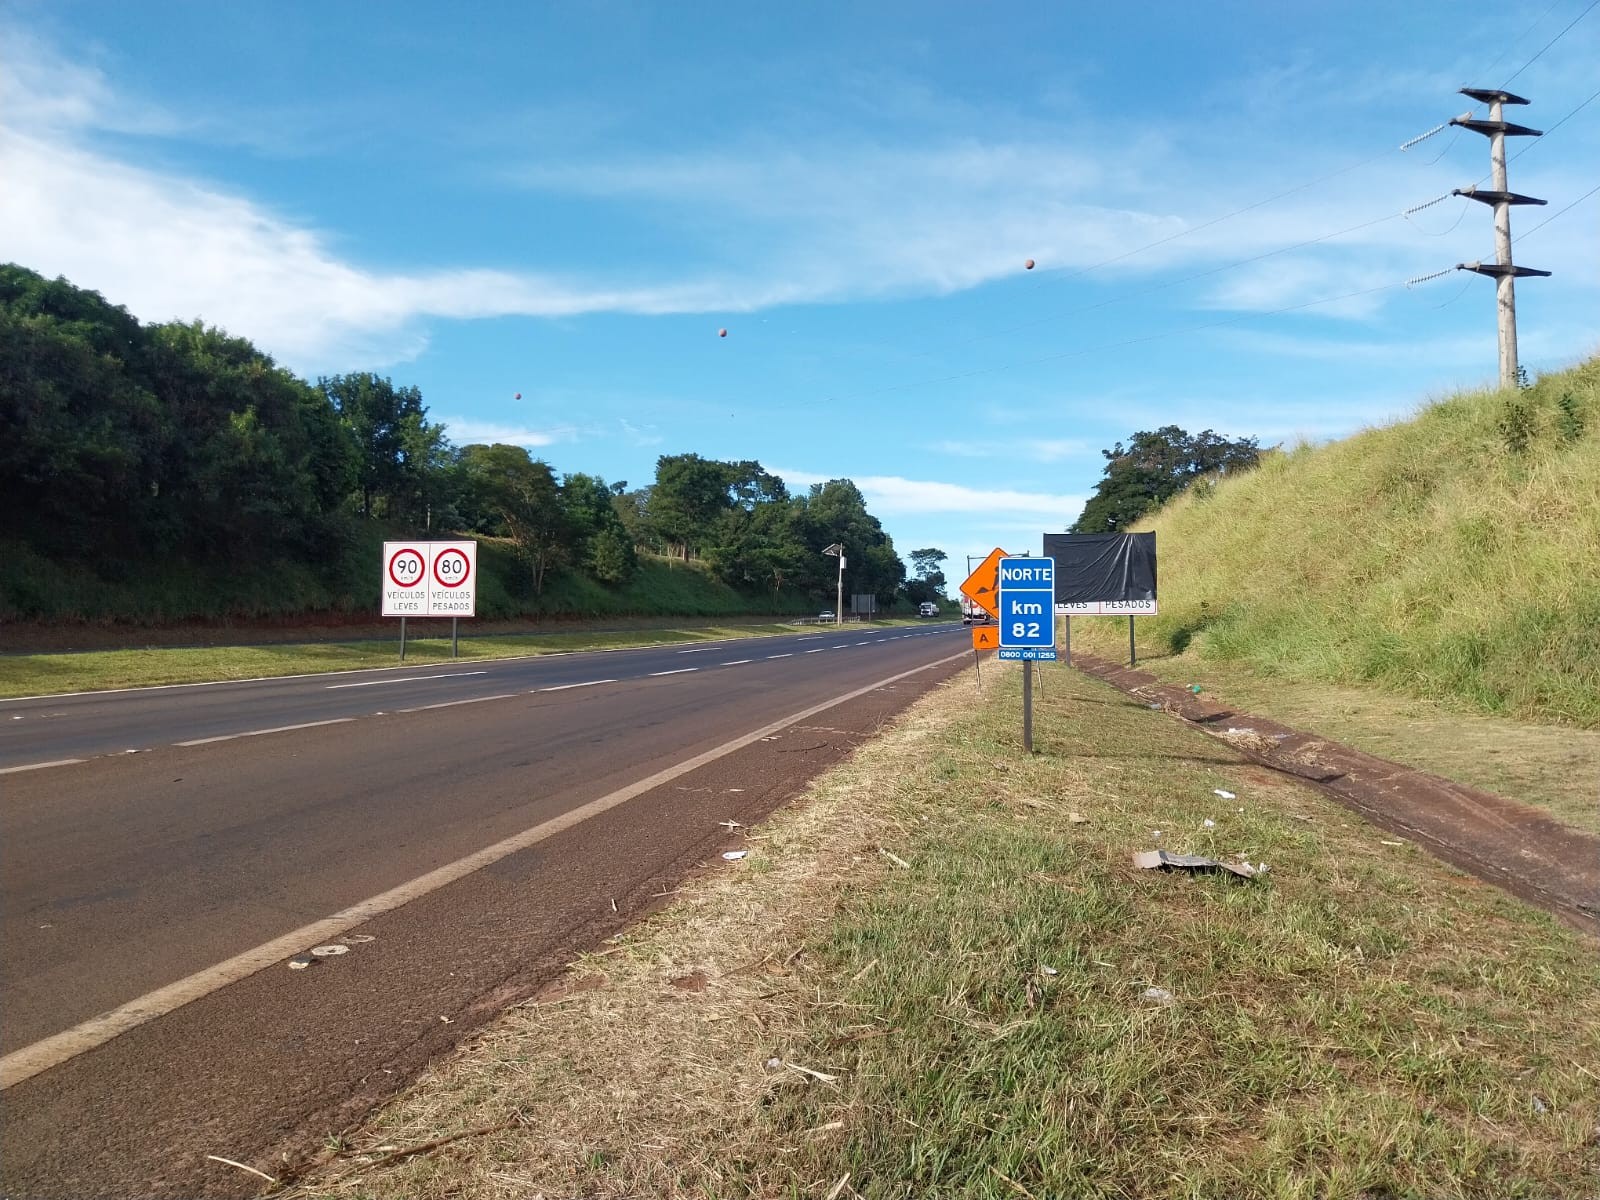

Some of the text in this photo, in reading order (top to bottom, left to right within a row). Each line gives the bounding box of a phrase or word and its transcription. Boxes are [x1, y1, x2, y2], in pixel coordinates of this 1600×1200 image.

[397, 560, 417, 574] 90
[442, 559, 462, 574] 80
[1001, 568, 1052, 581] NORTE
[431, 589, 471, 599] VEÍCULOS
[394, 603, 419, 611] LEVES
[432, 603, 470, 611] PESADOS
[1011, 600, 1042, 615] km
[1105, 600, 1151, 609] PESADOS
[1012, 622, 1040, 638] 82
[979, 634, 989, 643] A
[1023, 651, 1036, 659] 001
